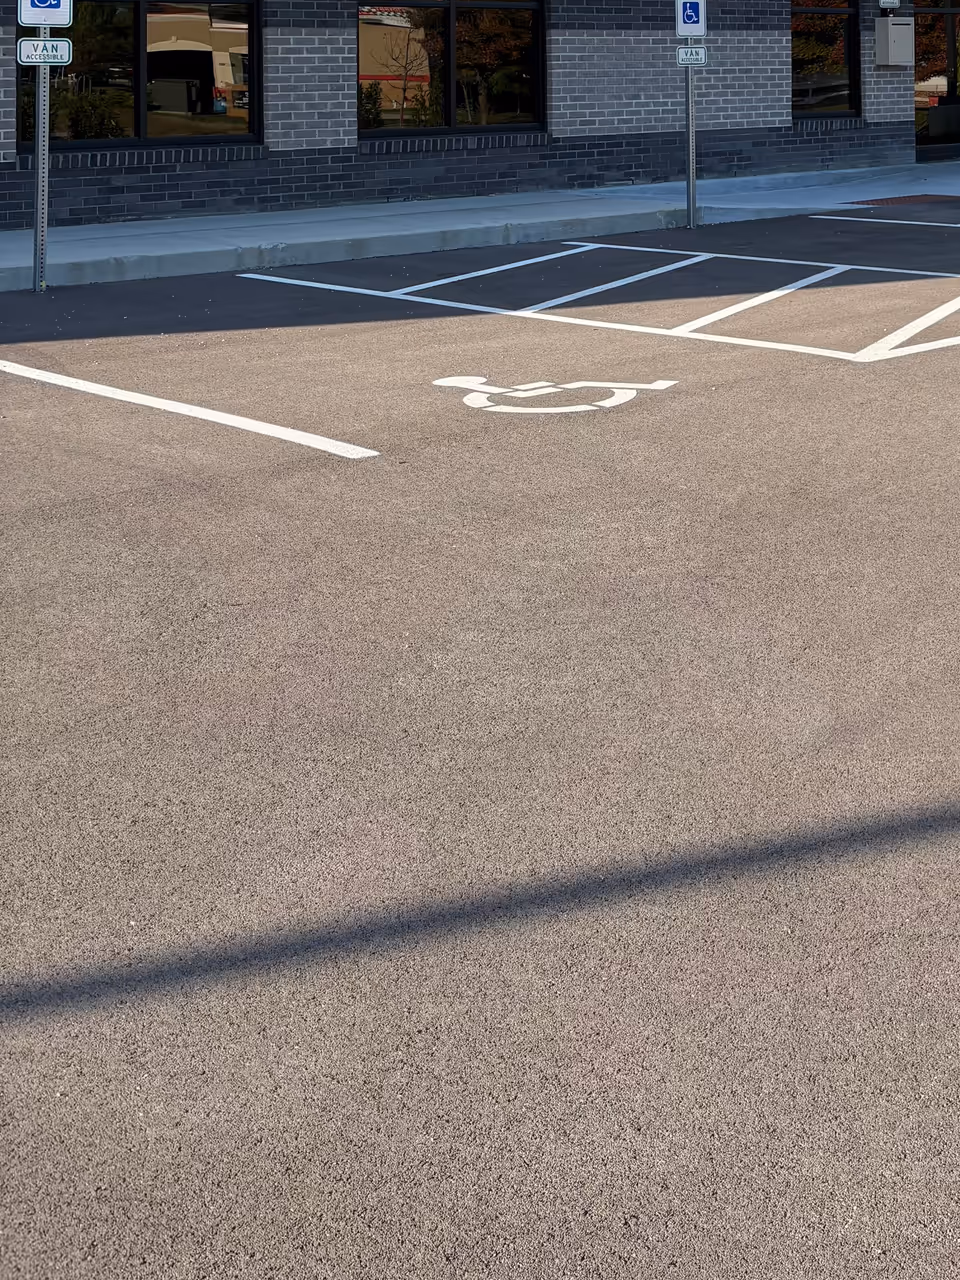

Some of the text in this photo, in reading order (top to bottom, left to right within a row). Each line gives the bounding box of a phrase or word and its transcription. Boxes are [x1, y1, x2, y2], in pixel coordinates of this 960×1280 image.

[32, 43, 59, 54] VAN
[25, 53, 65, 61] ACCESSIBLE
[684, 49, 700, 57] VAN
